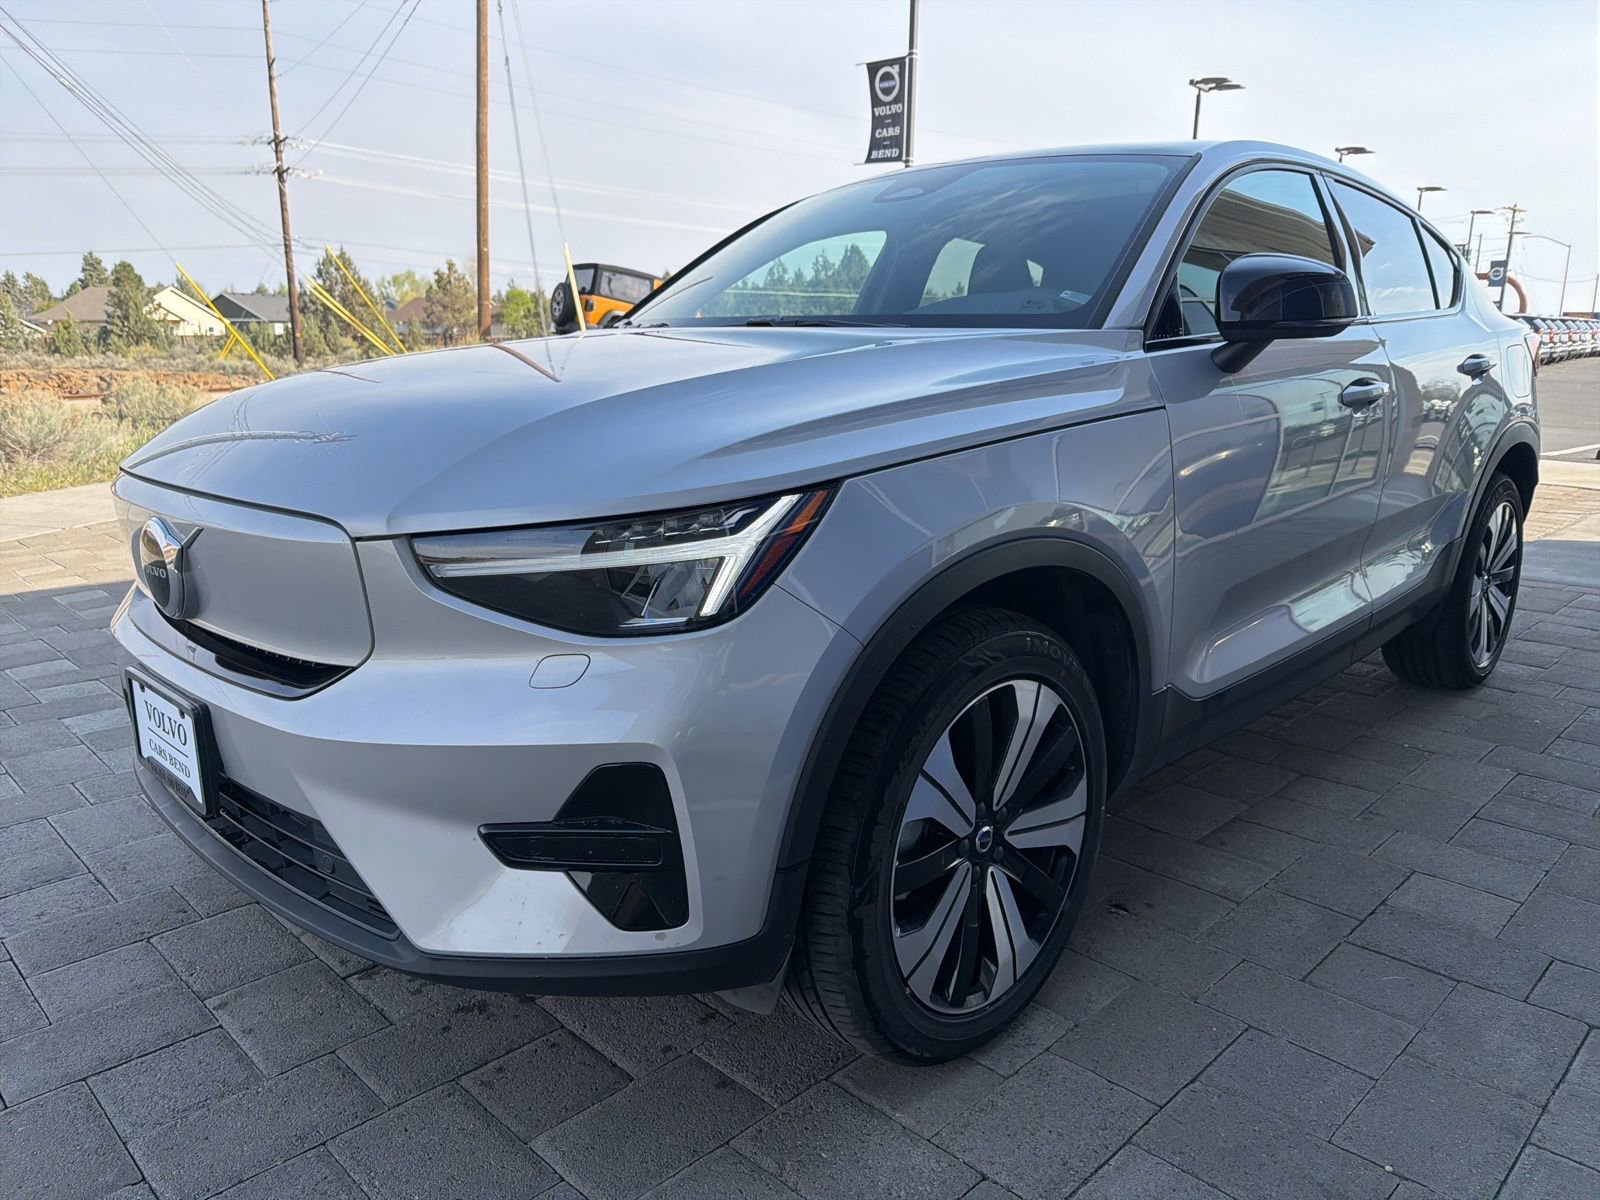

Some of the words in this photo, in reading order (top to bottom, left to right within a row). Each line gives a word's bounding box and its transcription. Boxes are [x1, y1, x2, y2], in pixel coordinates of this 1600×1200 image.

[873, 103, 903, 117] VOLVO
[875, 126, 901, 138] CARS
[870, 148, 899, 159] BEND
[144, 700, 187, 746] VOLVO
[149, 738, 168, 762] CARS
[168, 752, 191, 778] BEND
